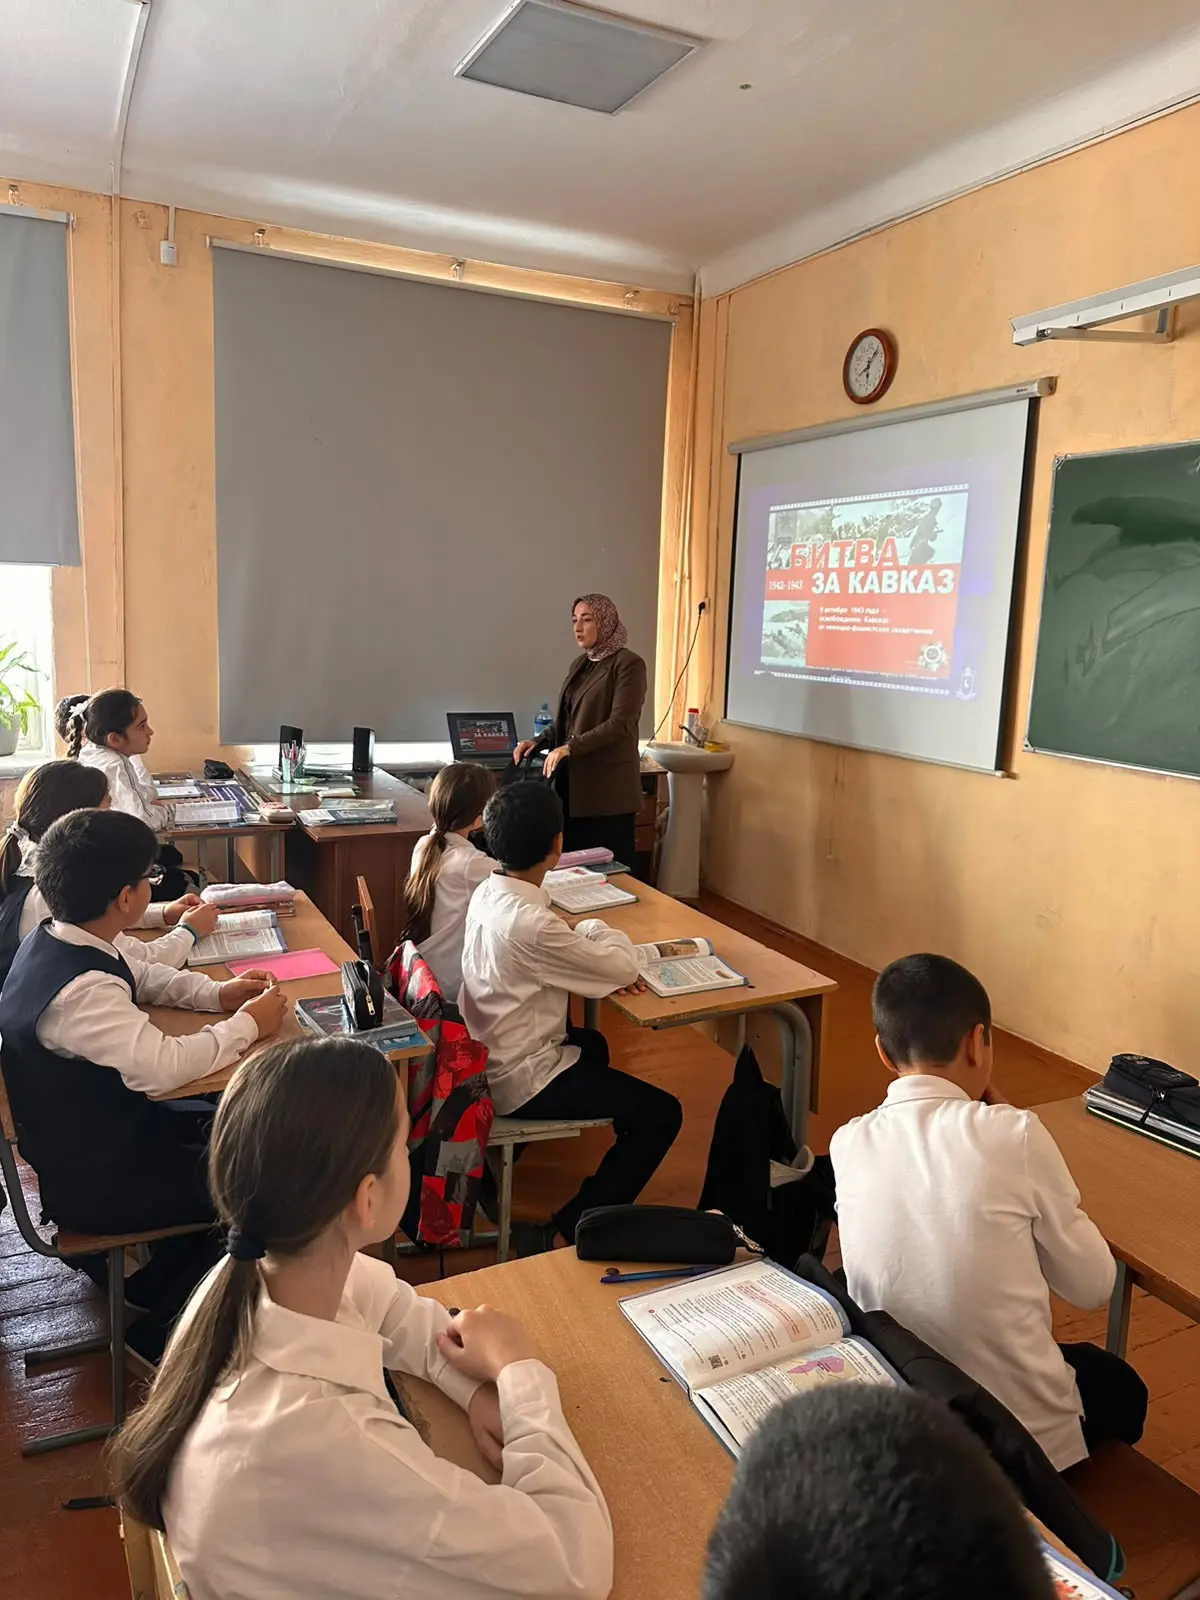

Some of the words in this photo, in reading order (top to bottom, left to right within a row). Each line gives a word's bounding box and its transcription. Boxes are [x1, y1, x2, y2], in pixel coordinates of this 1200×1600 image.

[790, 536, 901, 569] БИТВА
[768, 580, 803, 591] 1942-1943
[811, 572, 841, 595] ЗА
[848, 568, 955, 595] КАВКАЗ
